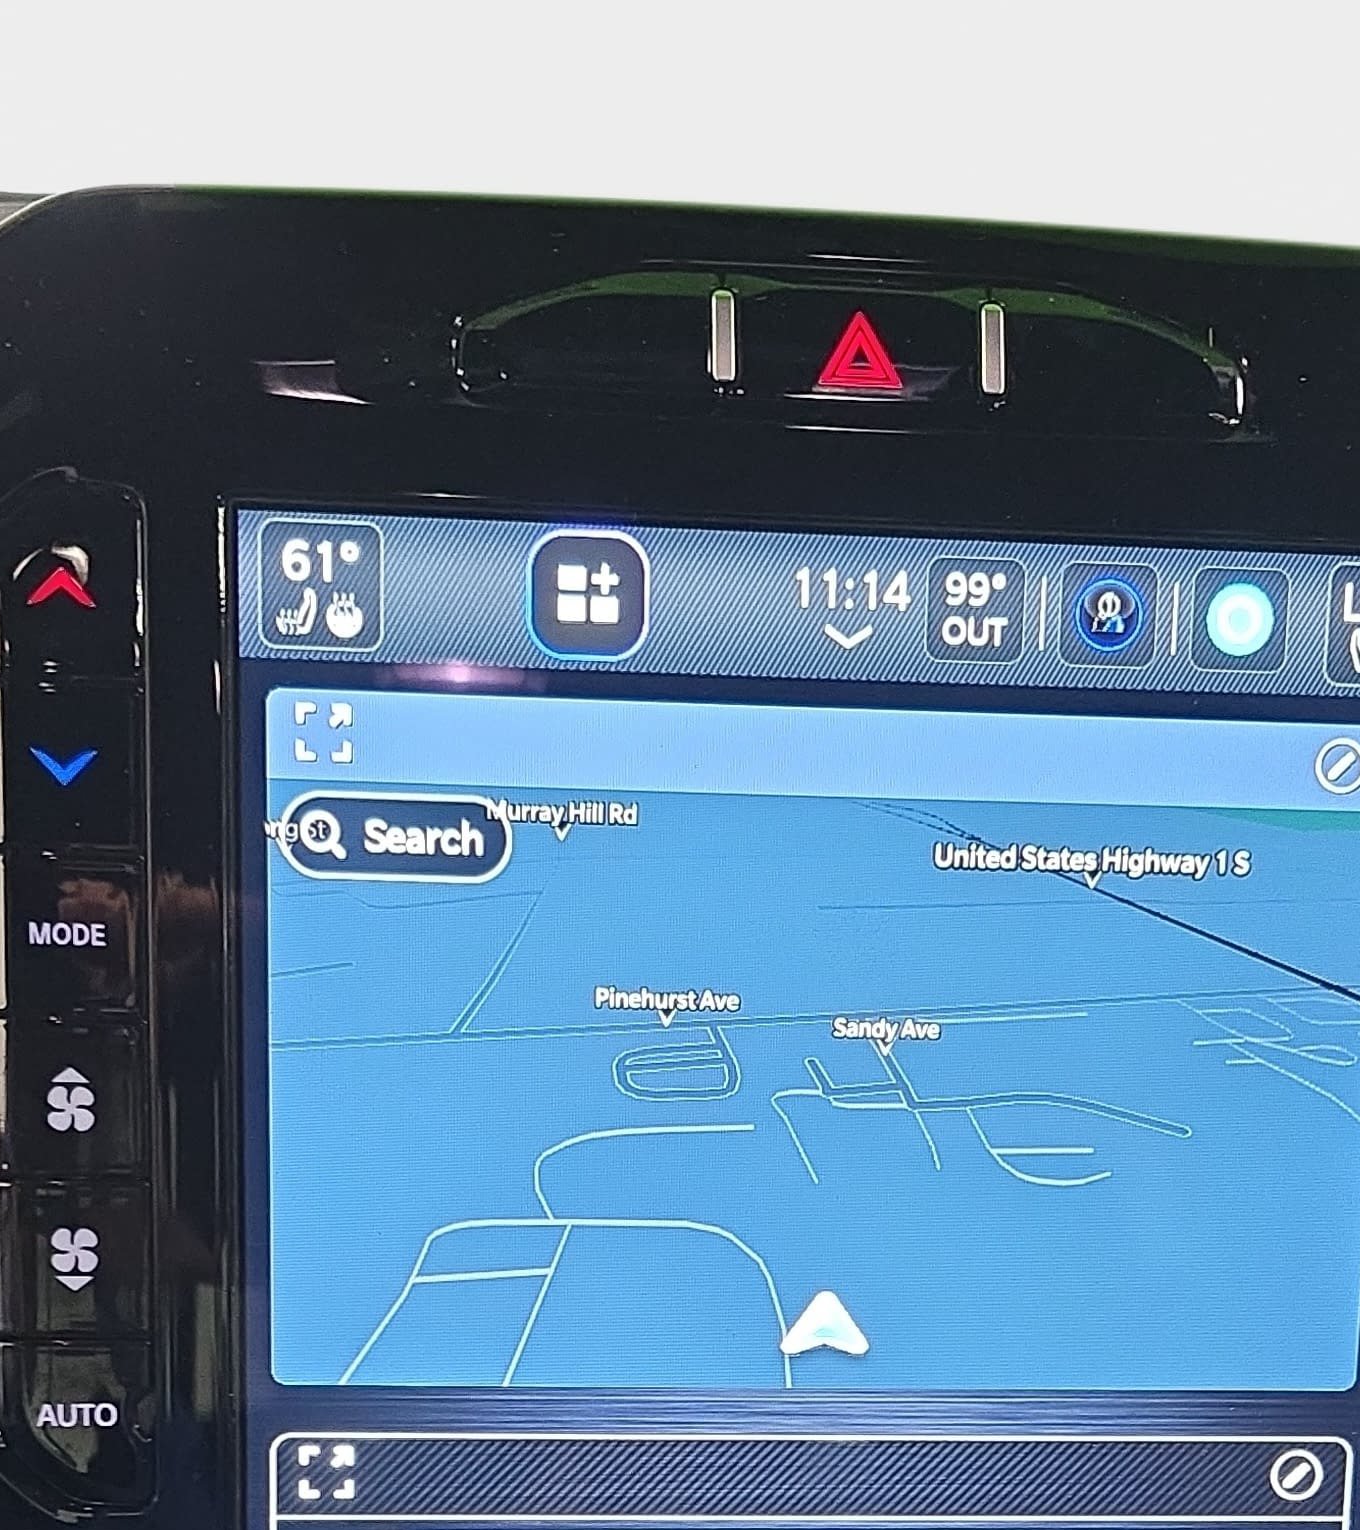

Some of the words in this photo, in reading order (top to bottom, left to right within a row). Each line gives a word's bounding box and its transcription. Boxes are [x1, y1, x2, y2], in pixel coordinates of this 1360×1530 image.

[795, 566, 912, 614] 11:14
[944, 571, 1007, 608] 99°
[941, 614, 1008, 649] OUT
[487, 798, 565, 827] Murray
[568, 800, 605, 824] Hill
[609, 801, 639, 826] Rd
[362, 819, 485, 857] Search
[933, 842, 1017, 871] United
[1021, 844, 1097, 873] States
[1101, 846, 1210, 879] Highway
[1216, 851, 1228, 875] 1
[1233, 851, 1252, 876] S
[28, 920, 108, 947] MODE
[594, 986, 695, 1010] Pinehurst
[698, 989, 740, 1013] Ave
[833, 1016, 897, 1043] Sandy
[901, 1018, 940, 1040] Ave
[36, 1403, 118, 1428] AUTO
